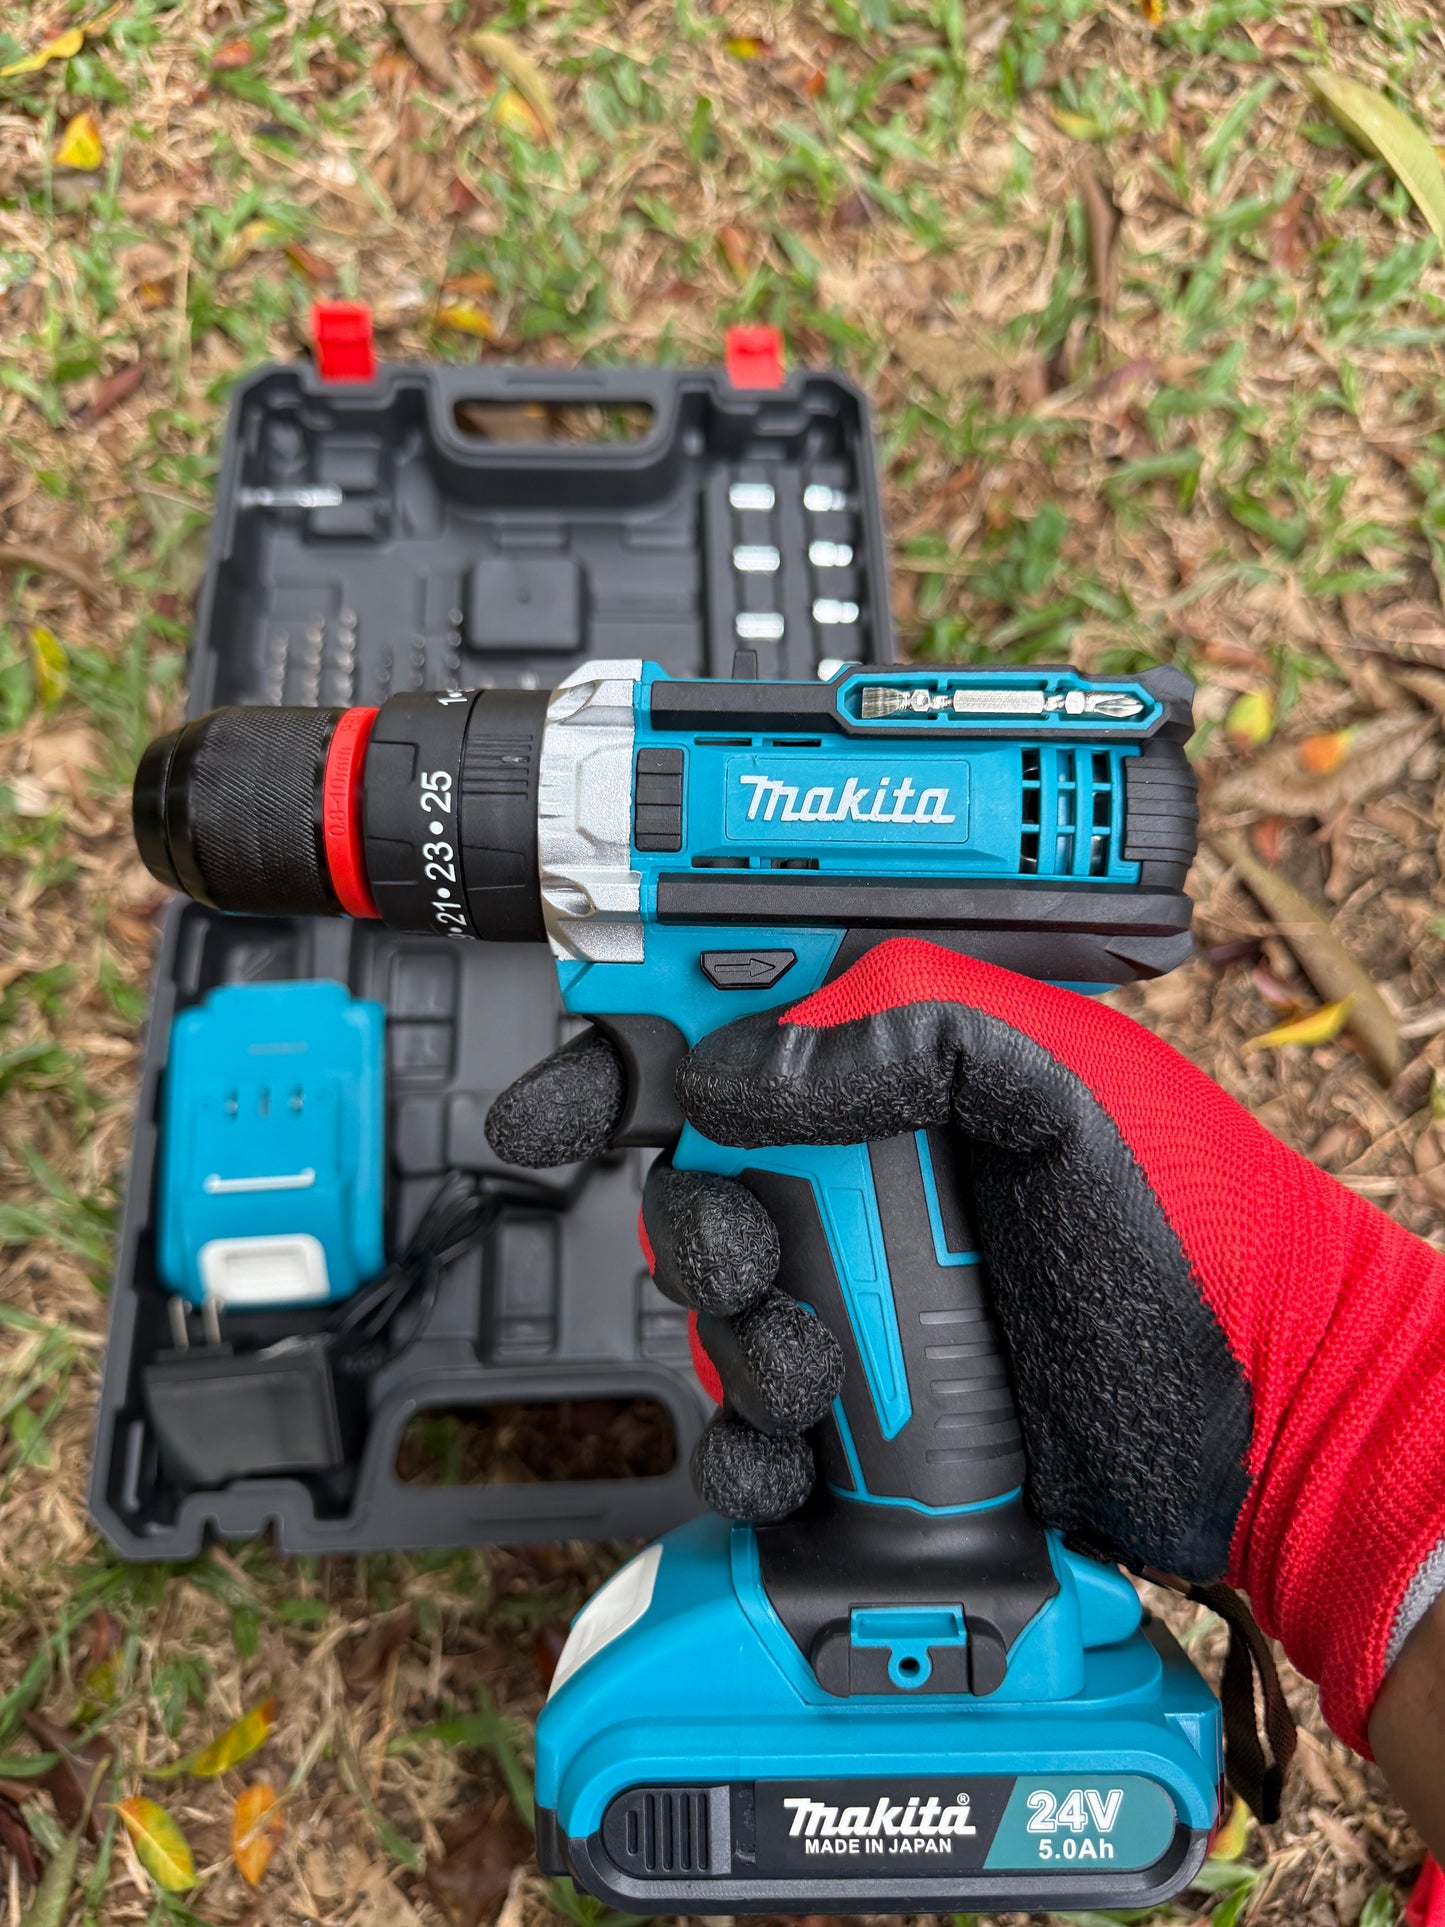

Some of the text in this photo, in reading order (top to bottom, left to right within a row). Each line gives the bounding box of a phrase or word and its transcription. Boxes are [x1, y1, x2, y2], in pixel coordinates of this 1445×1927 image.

[419, 770, 453, 814] 25
[422, 841, 457, 883] 23
[431, 901, 468, 926] 21
[1027, 1789, 1124, 1833] 24V
[805, 1838, 952, 1854] MADE IN JAPAN
[1038, 1837, 1114, 1860] 5.0Ah
